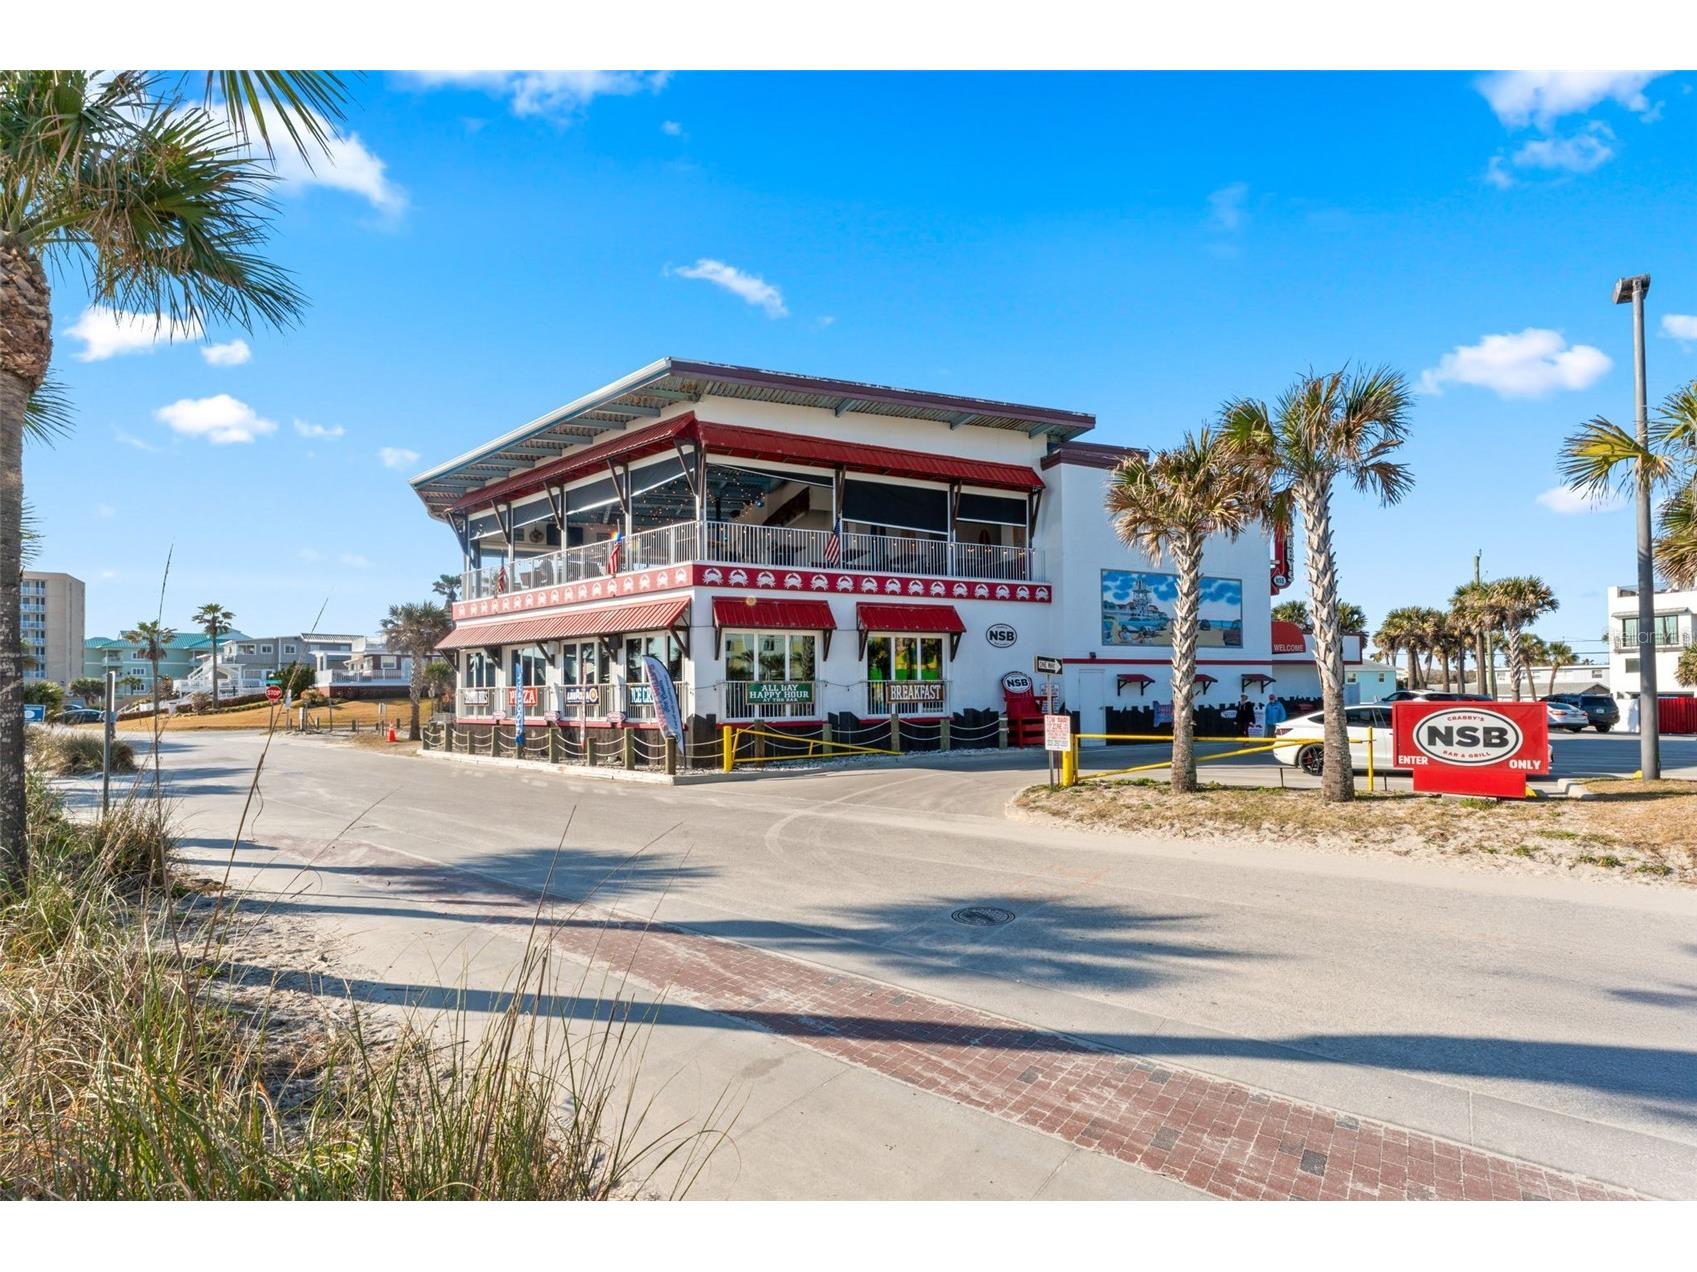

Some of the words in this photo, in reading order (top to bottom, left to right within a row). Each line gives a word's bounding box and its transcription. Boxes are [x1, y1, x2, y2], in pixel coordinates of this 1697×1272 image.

[989, 630, 1015, 641] NSB
[1274, 643, 1304, 652] WELCOME
[1006, 678, 1028, 687] NSB
[761, 684, 779, 692] ALL
[781, 684, 798, 692] DAY
[890, 684, 941, 700] BREAKFAST
[509, 690, 536, 703] PIZA
[631, 687, 642, 703] ICE
[1427, 726, 1509, 748] NSB
[1398, 755, 1428, 765] ENTER
[1509, 760, 1541, 770] ONLY
